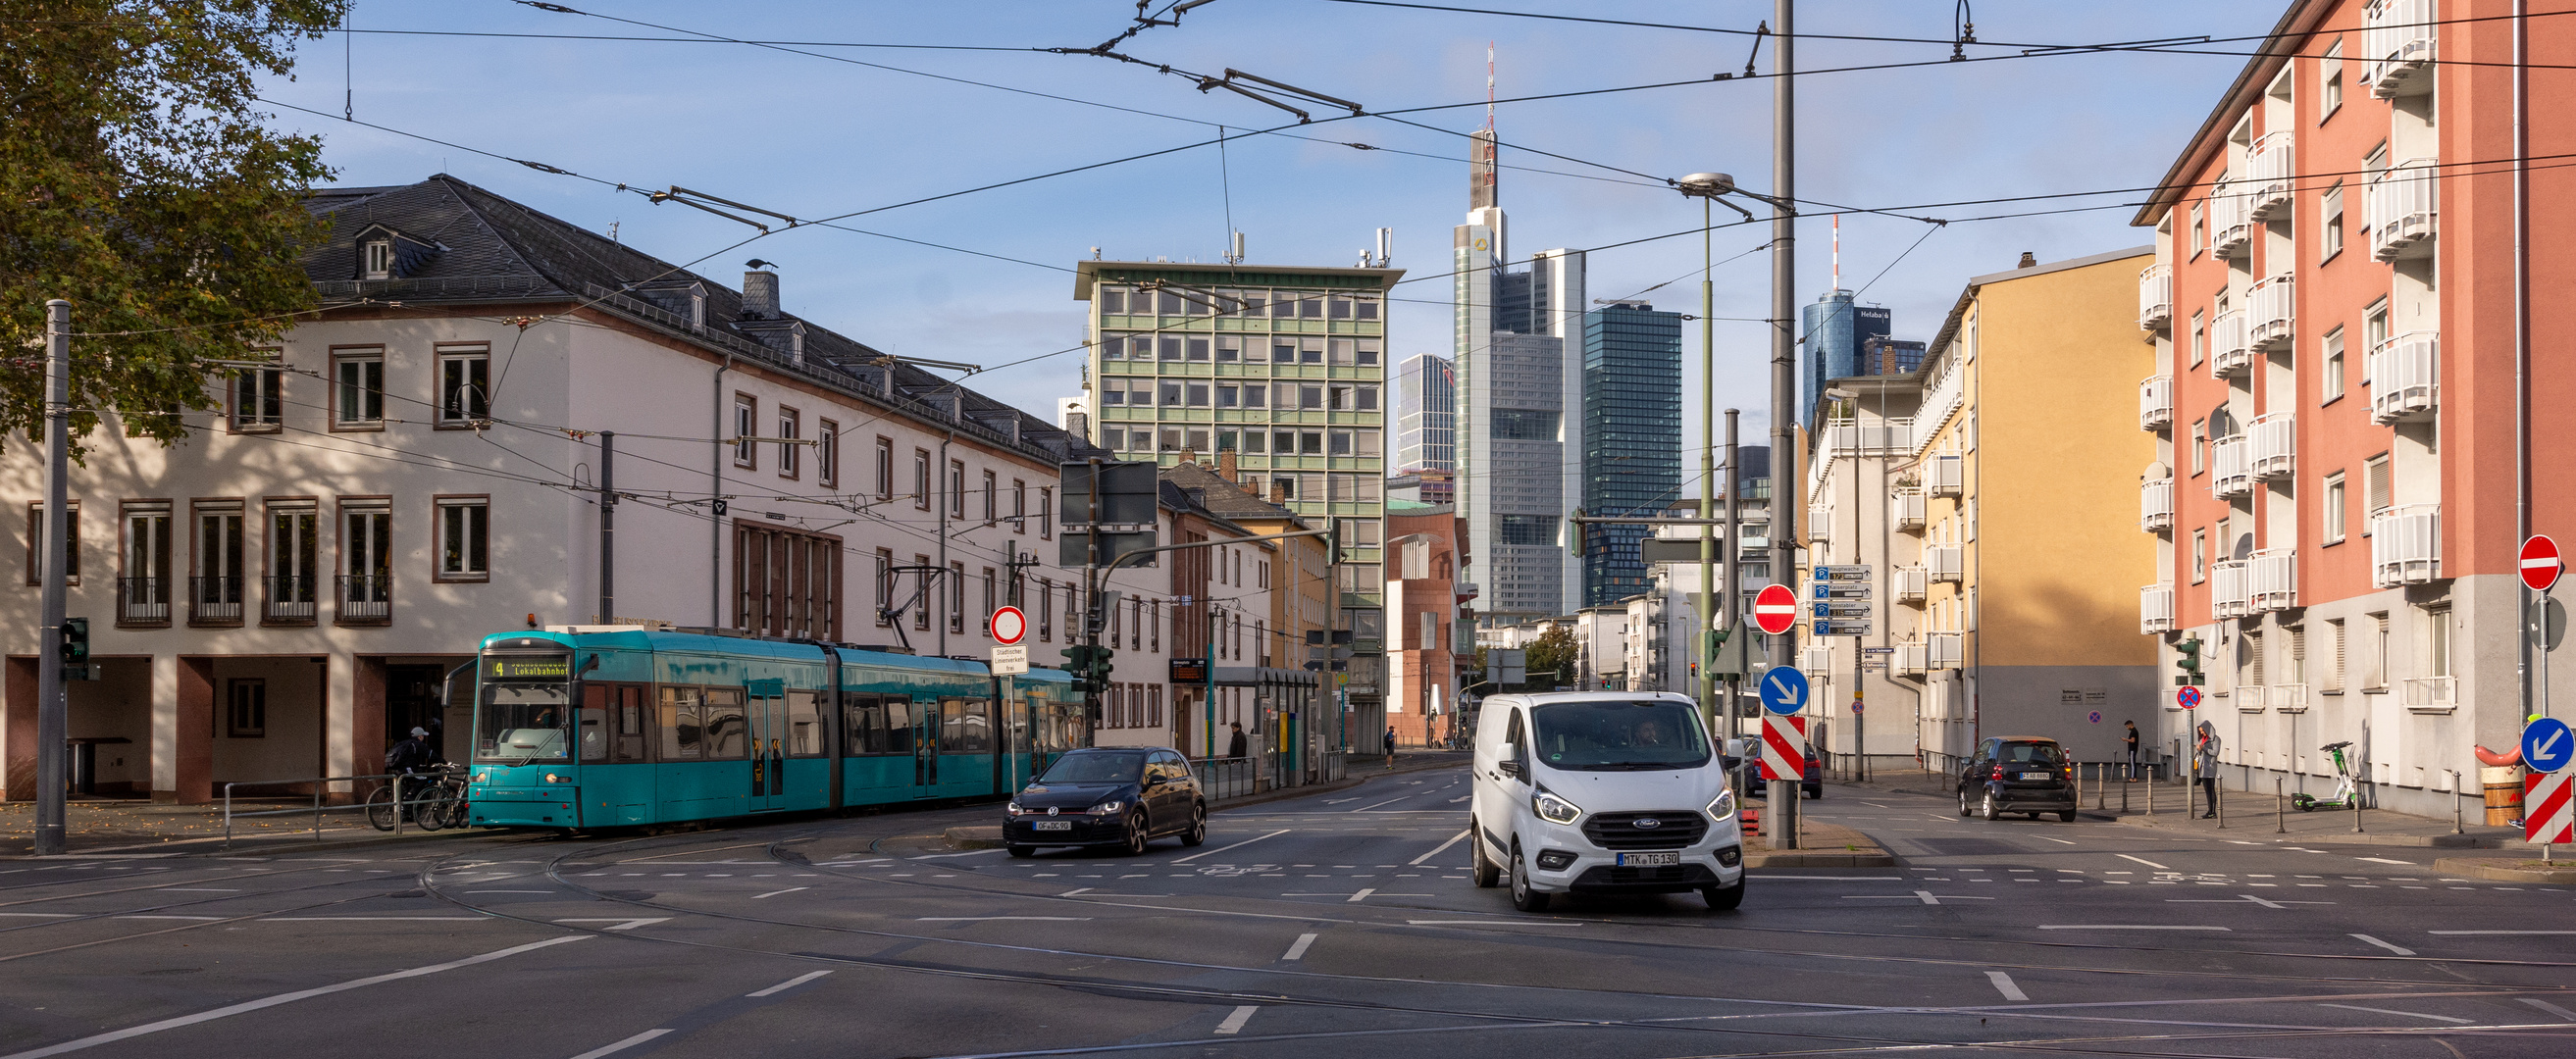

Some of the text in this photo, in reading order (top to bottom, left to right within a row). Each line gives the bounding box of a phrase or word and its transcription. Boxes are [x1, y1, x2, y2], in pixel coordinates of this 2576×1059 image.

[1860, 310, 1882, 319] Helaba
[515, 667, 568, 676] Lokalbahnhof
[1623, 854, 1677, 865] MTK TG 130
